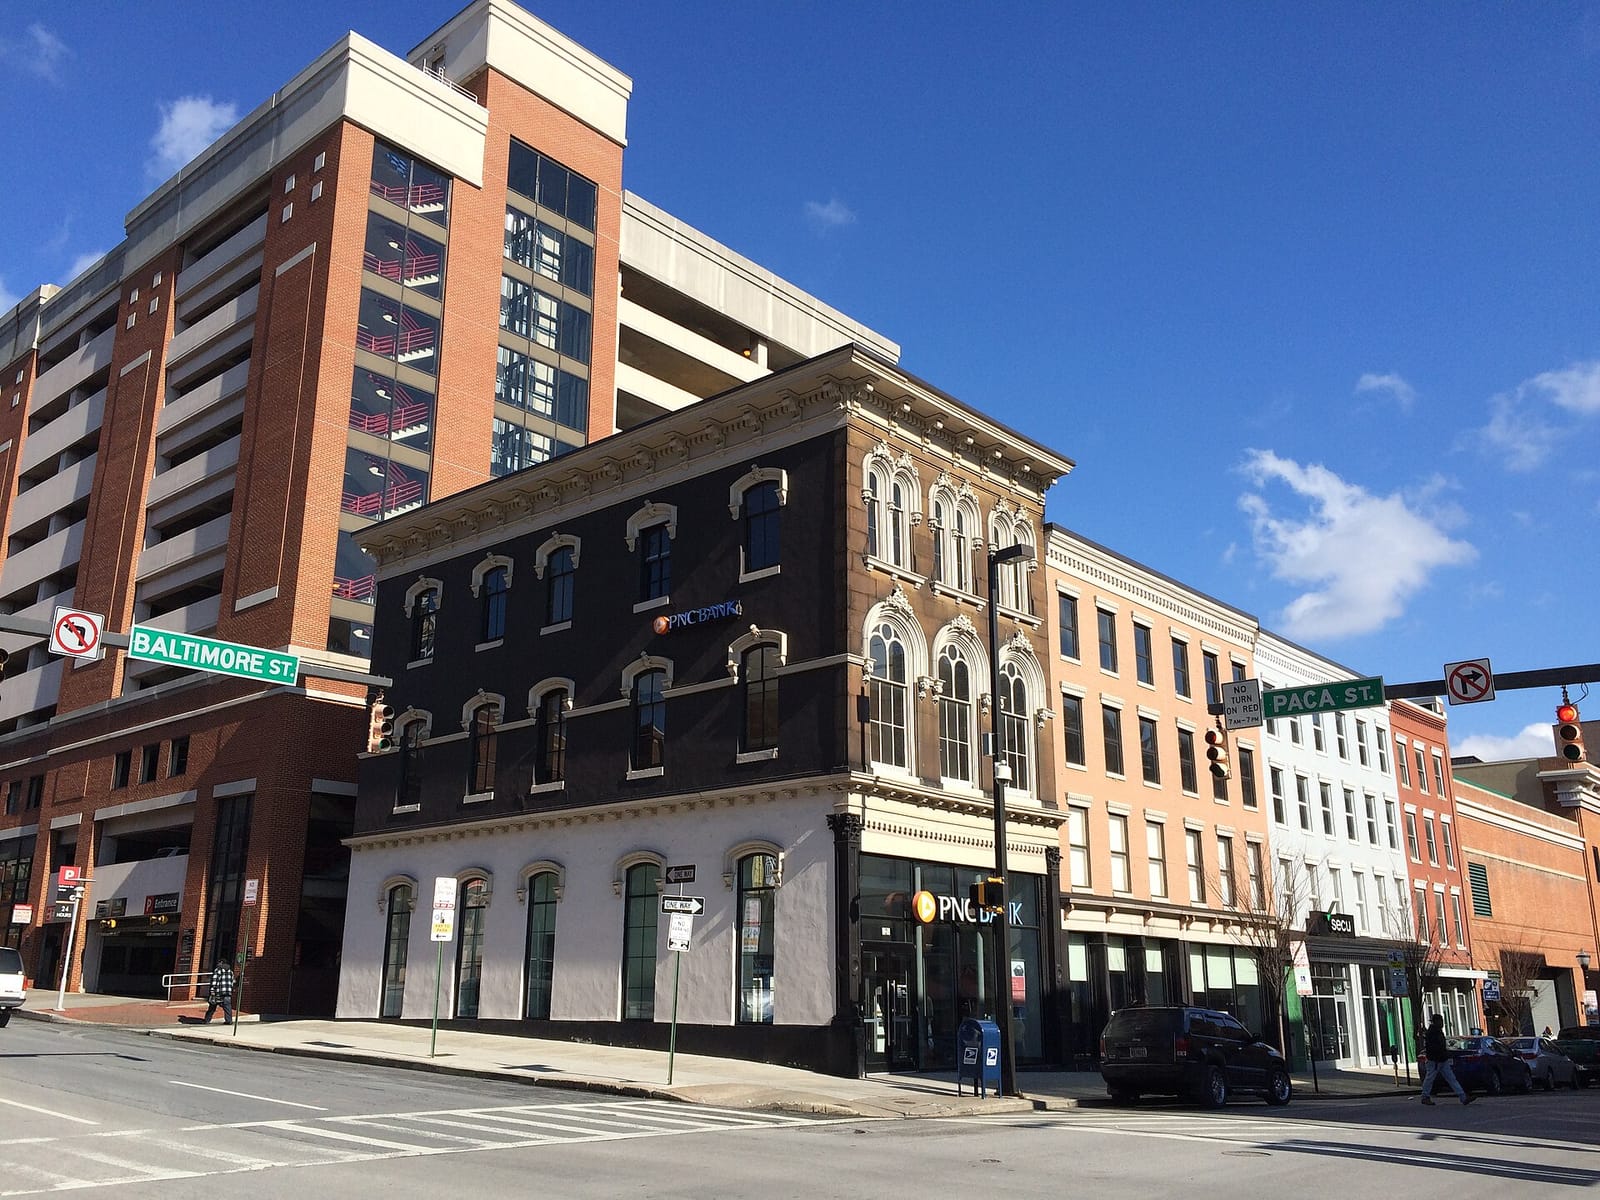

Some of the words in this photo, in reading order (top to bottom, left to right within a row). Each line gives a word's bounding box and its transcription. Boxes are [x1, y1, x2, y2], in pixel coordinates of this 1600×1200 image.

[669, 610, 697, 629] PNC
[699, 600, 737, 622] BANK
[133, 632, 265, 674] BALTIMORE
[269, 659, 295, 678] ST.
[1233, 685, 1247, 694] NO
[1231, 694, 1252, 705] TURN
[1273, 688, 1336, 714] PACA
[1344, 686, 1374, 704] ST.
[1226, 706, 1238, 715] ON
[1242, 704, 1259, 713] RED
[674, 870, 682, 878] ONE
[683, 869, 692, 877] WAY
[155, 898, 178, 909] Entrance
[666, 901, 678, 909] ONE
[937, 895, 977, 923] PNC
[1331, 918, 1352, 933] secu
